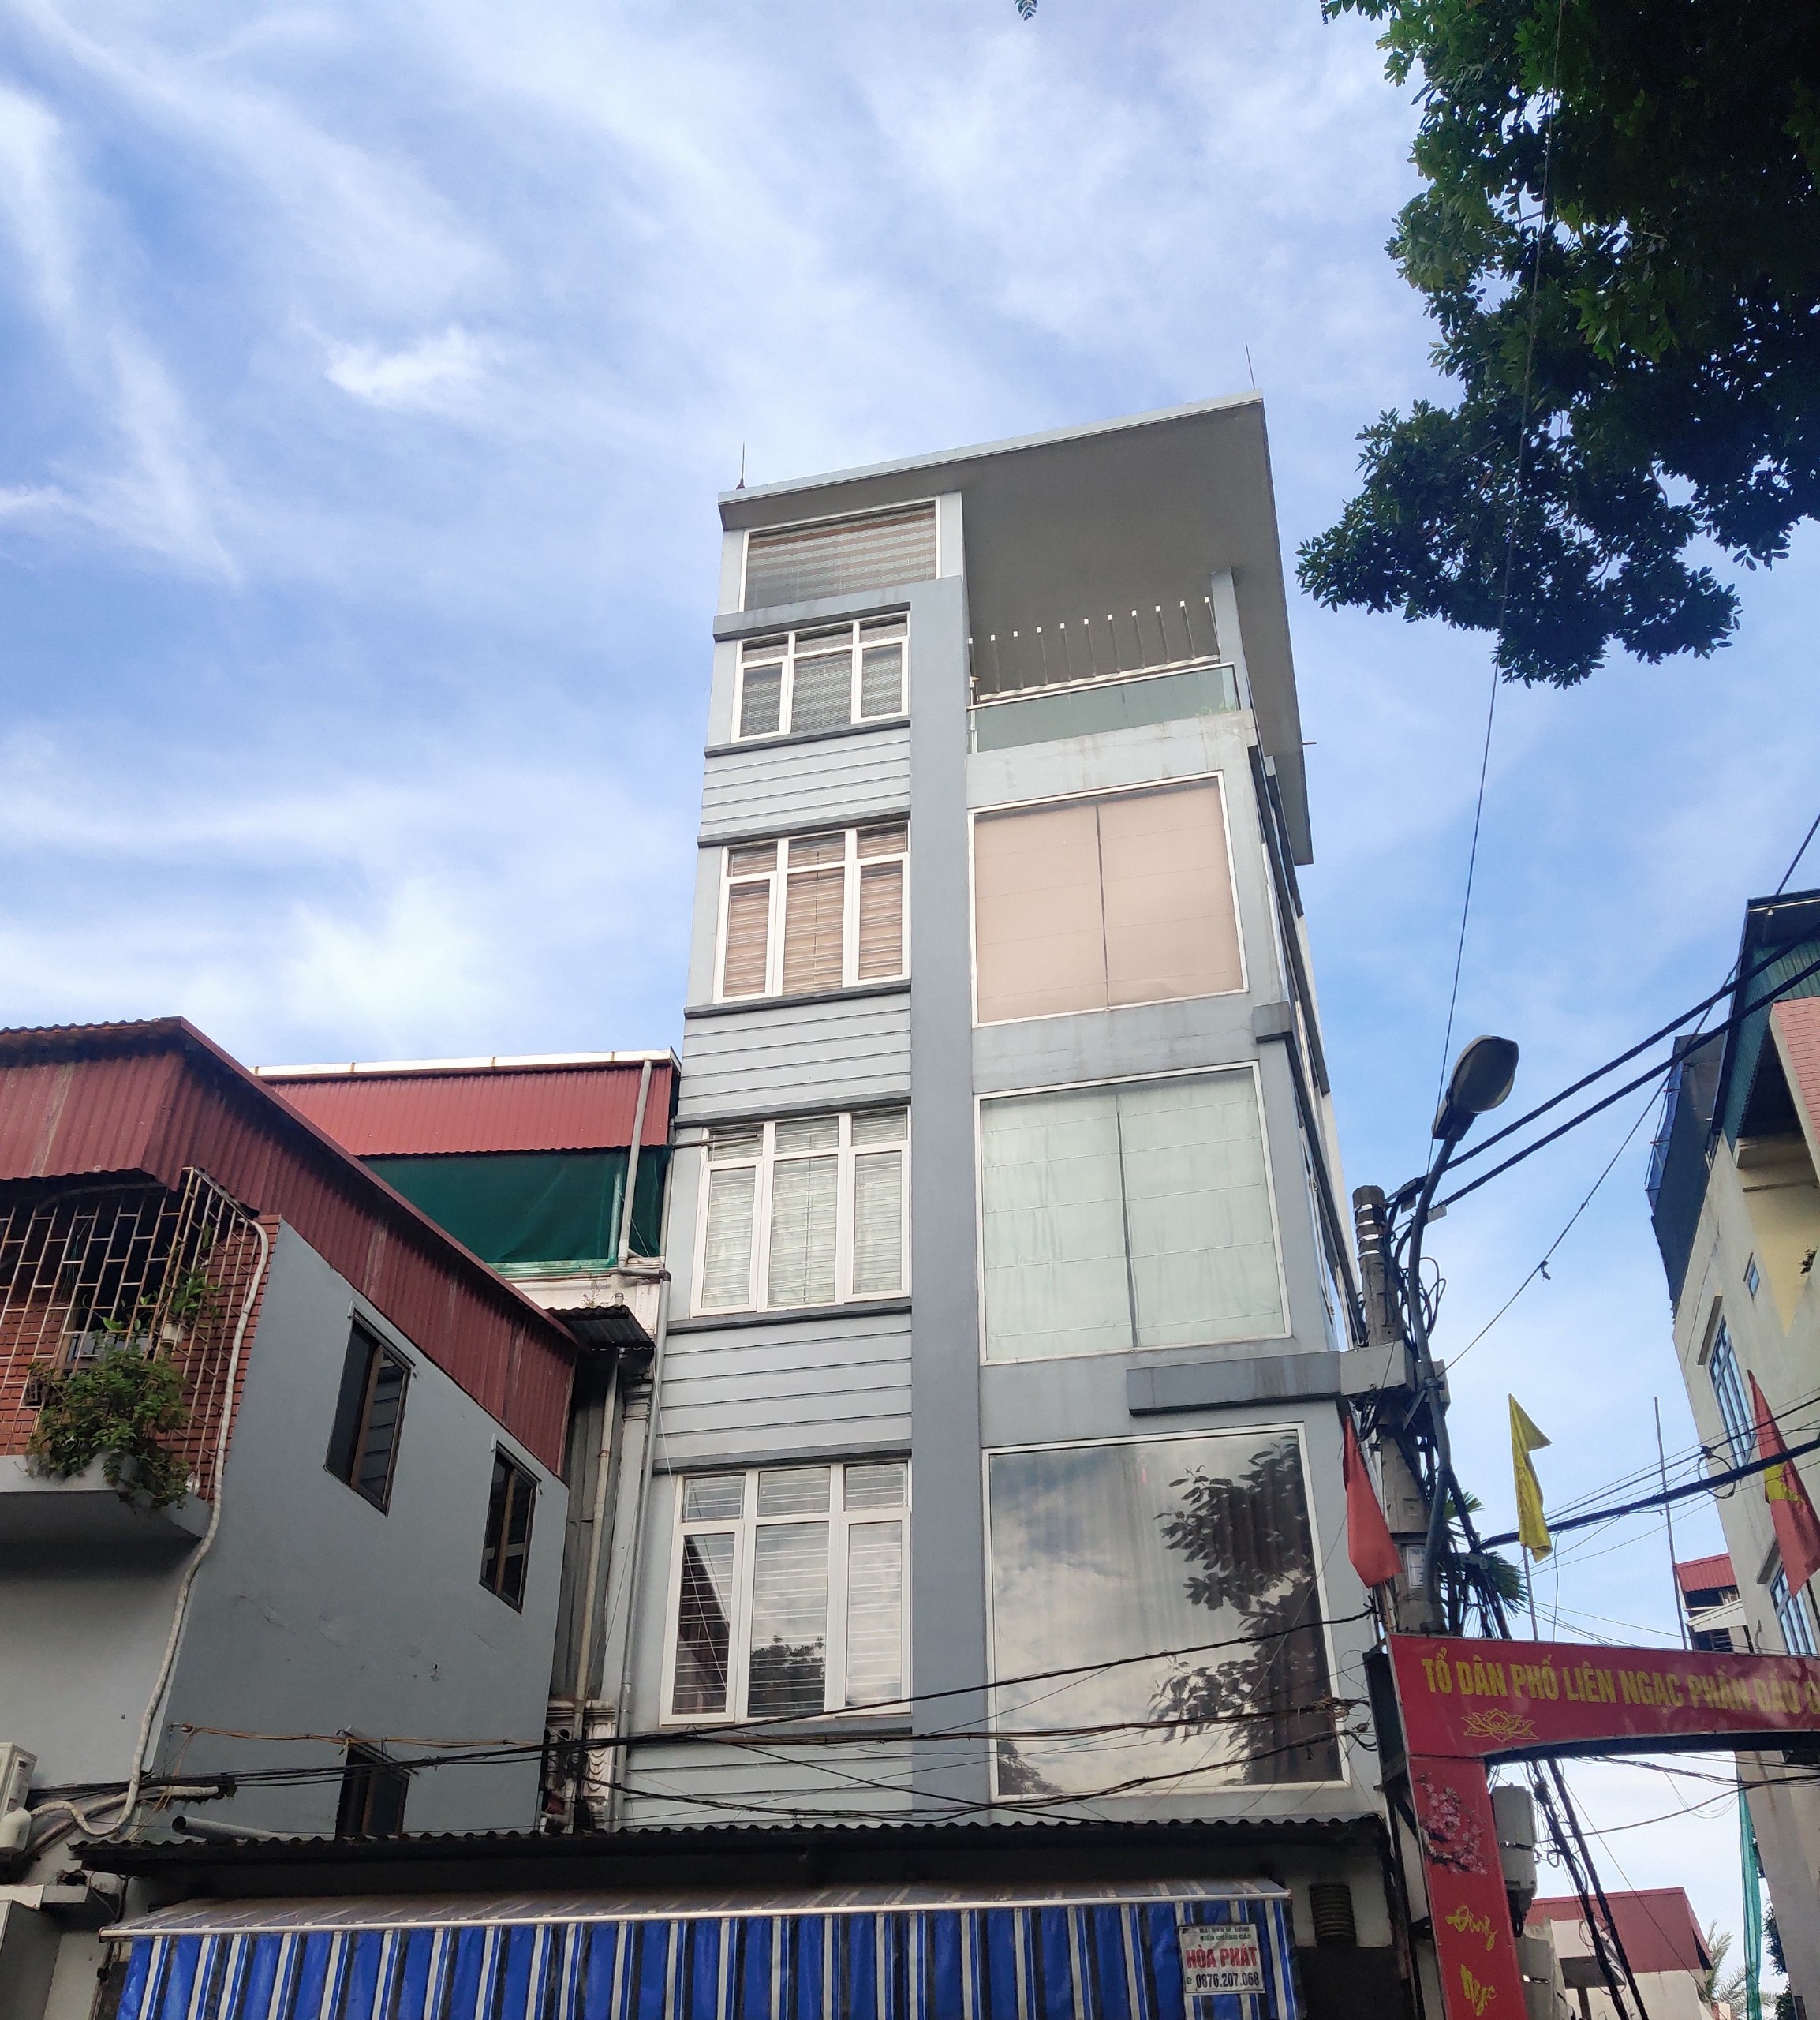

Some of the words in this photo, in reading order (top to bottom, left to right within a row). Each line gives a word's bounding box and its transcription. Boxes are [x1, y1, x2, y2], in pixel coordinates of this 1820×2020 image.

[1422, 1647, 1453, 1694] TỔ
[1456, 1654, 1508, 1697] DÂN
[1510, 1654, 1560, 1700] PHỐ
[1562, 1661, 1618, 1704] LIÊN
[1619, 1670, 1684, 1715] NGẠC
[1186, 1944, 1216, 1968] HÒA
[1220, 1943, 1257, 1967] PHÁT
[1196, 1971, 1260, 1988] 0876.207.068
